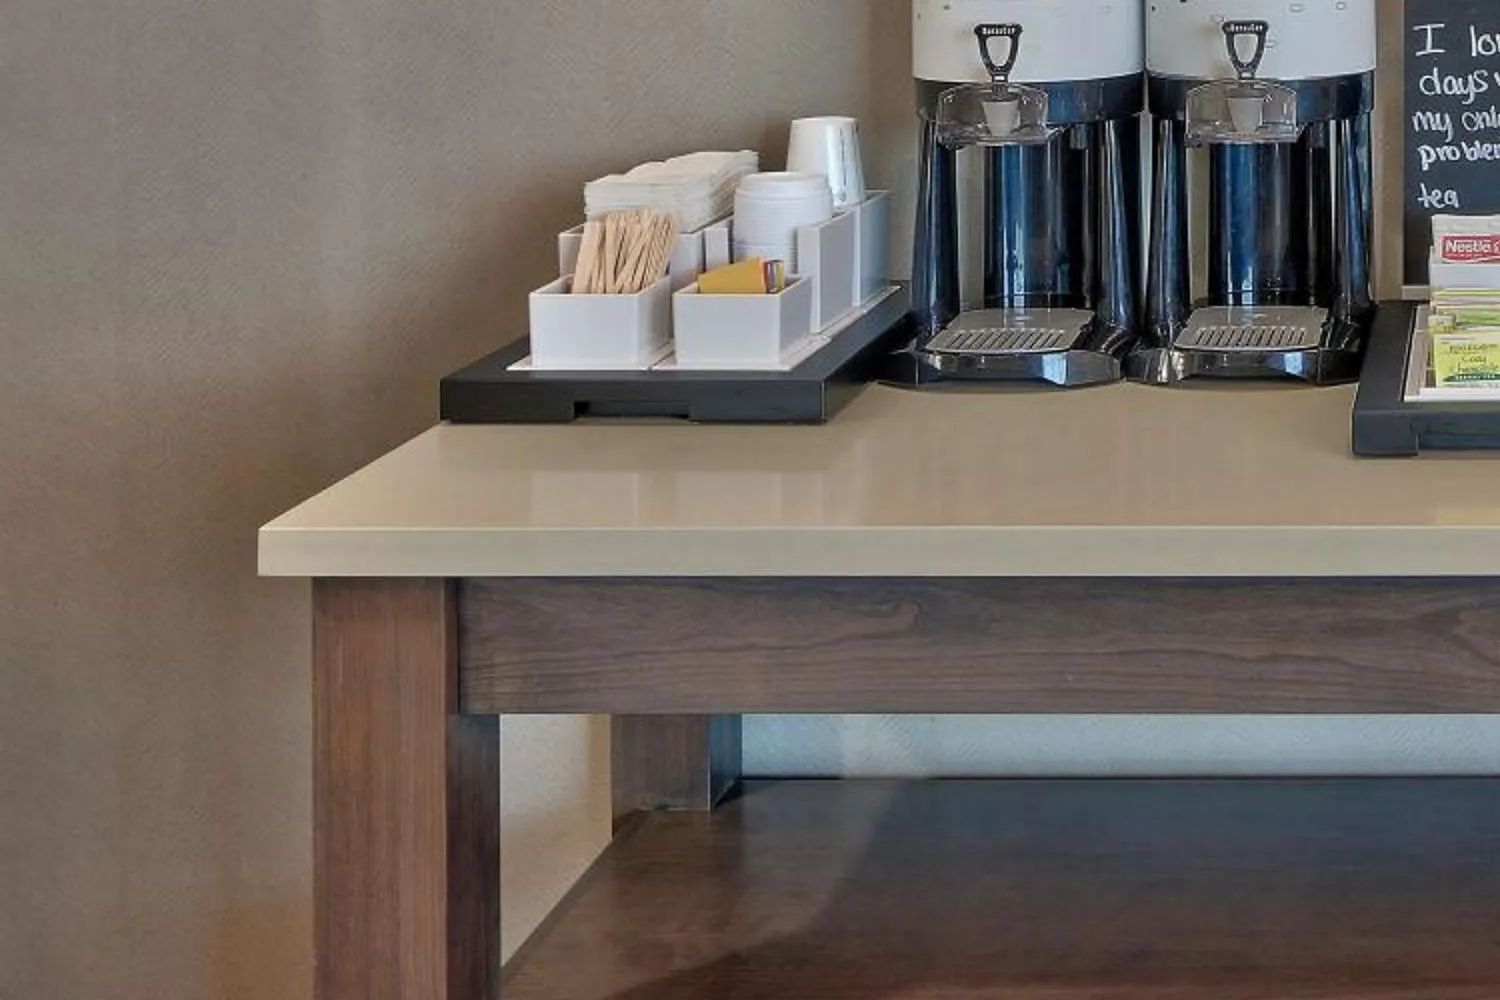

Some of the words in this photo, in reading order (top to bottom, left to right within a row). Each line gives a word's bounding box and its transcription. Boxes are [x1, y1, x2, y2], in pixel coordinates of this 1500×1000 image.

[1412, 23, 1445, 56] I
[1419, 67, 1489, 104] days
[1412, 110, 1454, 142] my
[1417, 182, 1460, 208] tea
